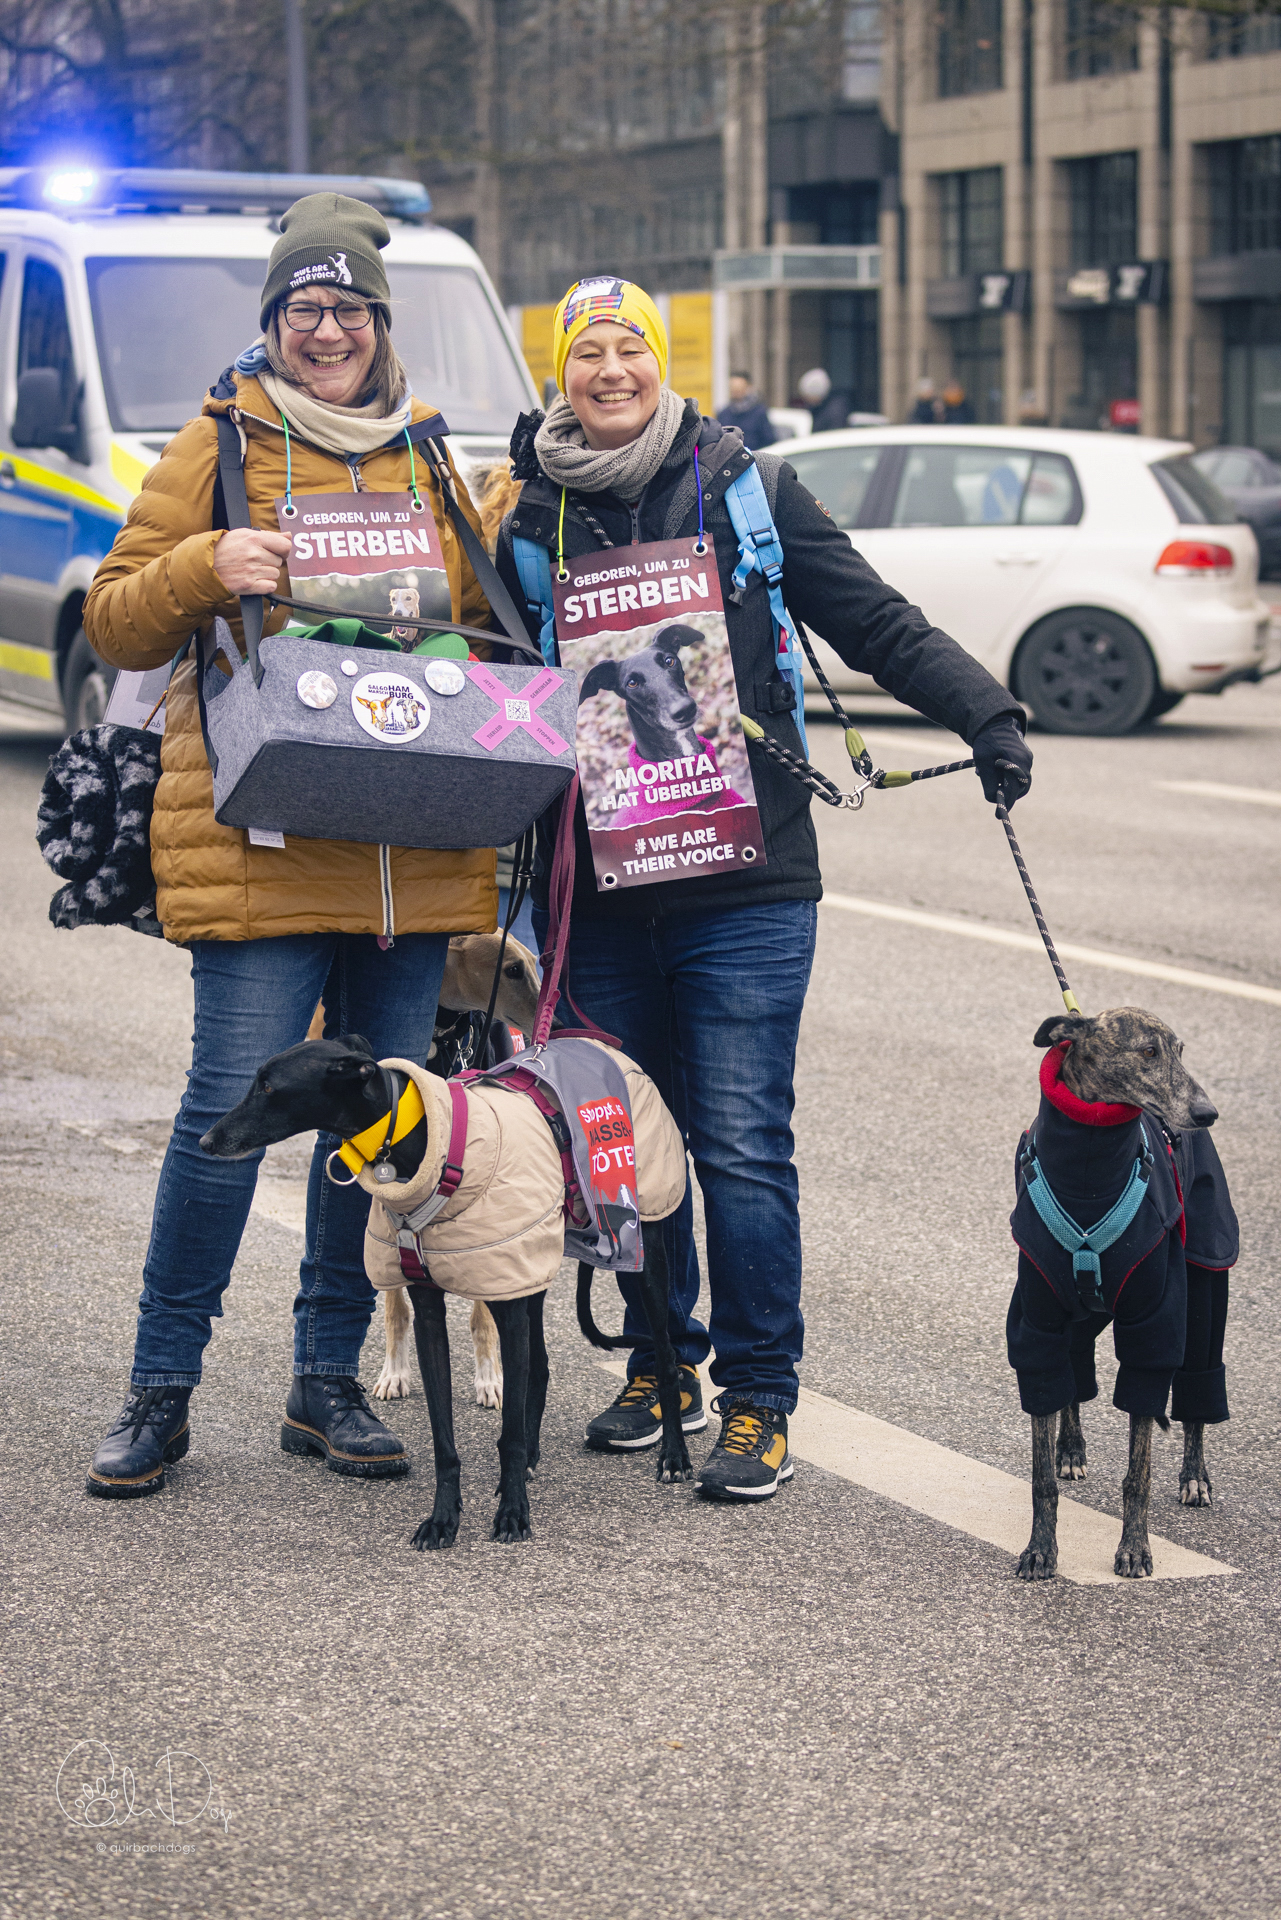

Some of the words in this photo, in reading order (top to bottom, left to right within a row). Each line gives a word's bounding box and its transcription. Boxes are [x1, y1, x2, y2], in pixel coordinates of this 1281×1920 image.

[289, 273, 311, 288] THEIR
[311, 270, 336, 280] VOICE
[293, 266, 311, 278] #WE
[311, 264, 328, 273] ARE
[302, 512, 369, 525] GEBOREN,
[370, 511, 391, 523] UM
[394, 512, 411, 523] ZU
[293, 528, 431, 560] STERBEN
[573, 565, 642, 588] GEBOREN,
[644, 560, 668, 574] UM
[672, 558, 690, 570] ZU
[563, 572, 710, 623] STERBEN
[388, 685, 410, 693] HAM
[389, 691, 414, 699] BURG
[483, 679, 496, 691] JETZT
[530, 677, 553, 699] GEMEINSAM
[536, 727, 556, 746] STOPPEN
[615, 753, 716, 790] MORITA
[602, 791, 639, 811] HAT
[644, 774, 732, 804] ÜBERLEBT
[647, 833, 678, 852] WE
[681, 826, 717, 847] ARE
[622, 853, 676, 876] THEIR
[677, 843, 735, 867] VOICE
[579, 1102, 616, 1123] Stoppt
